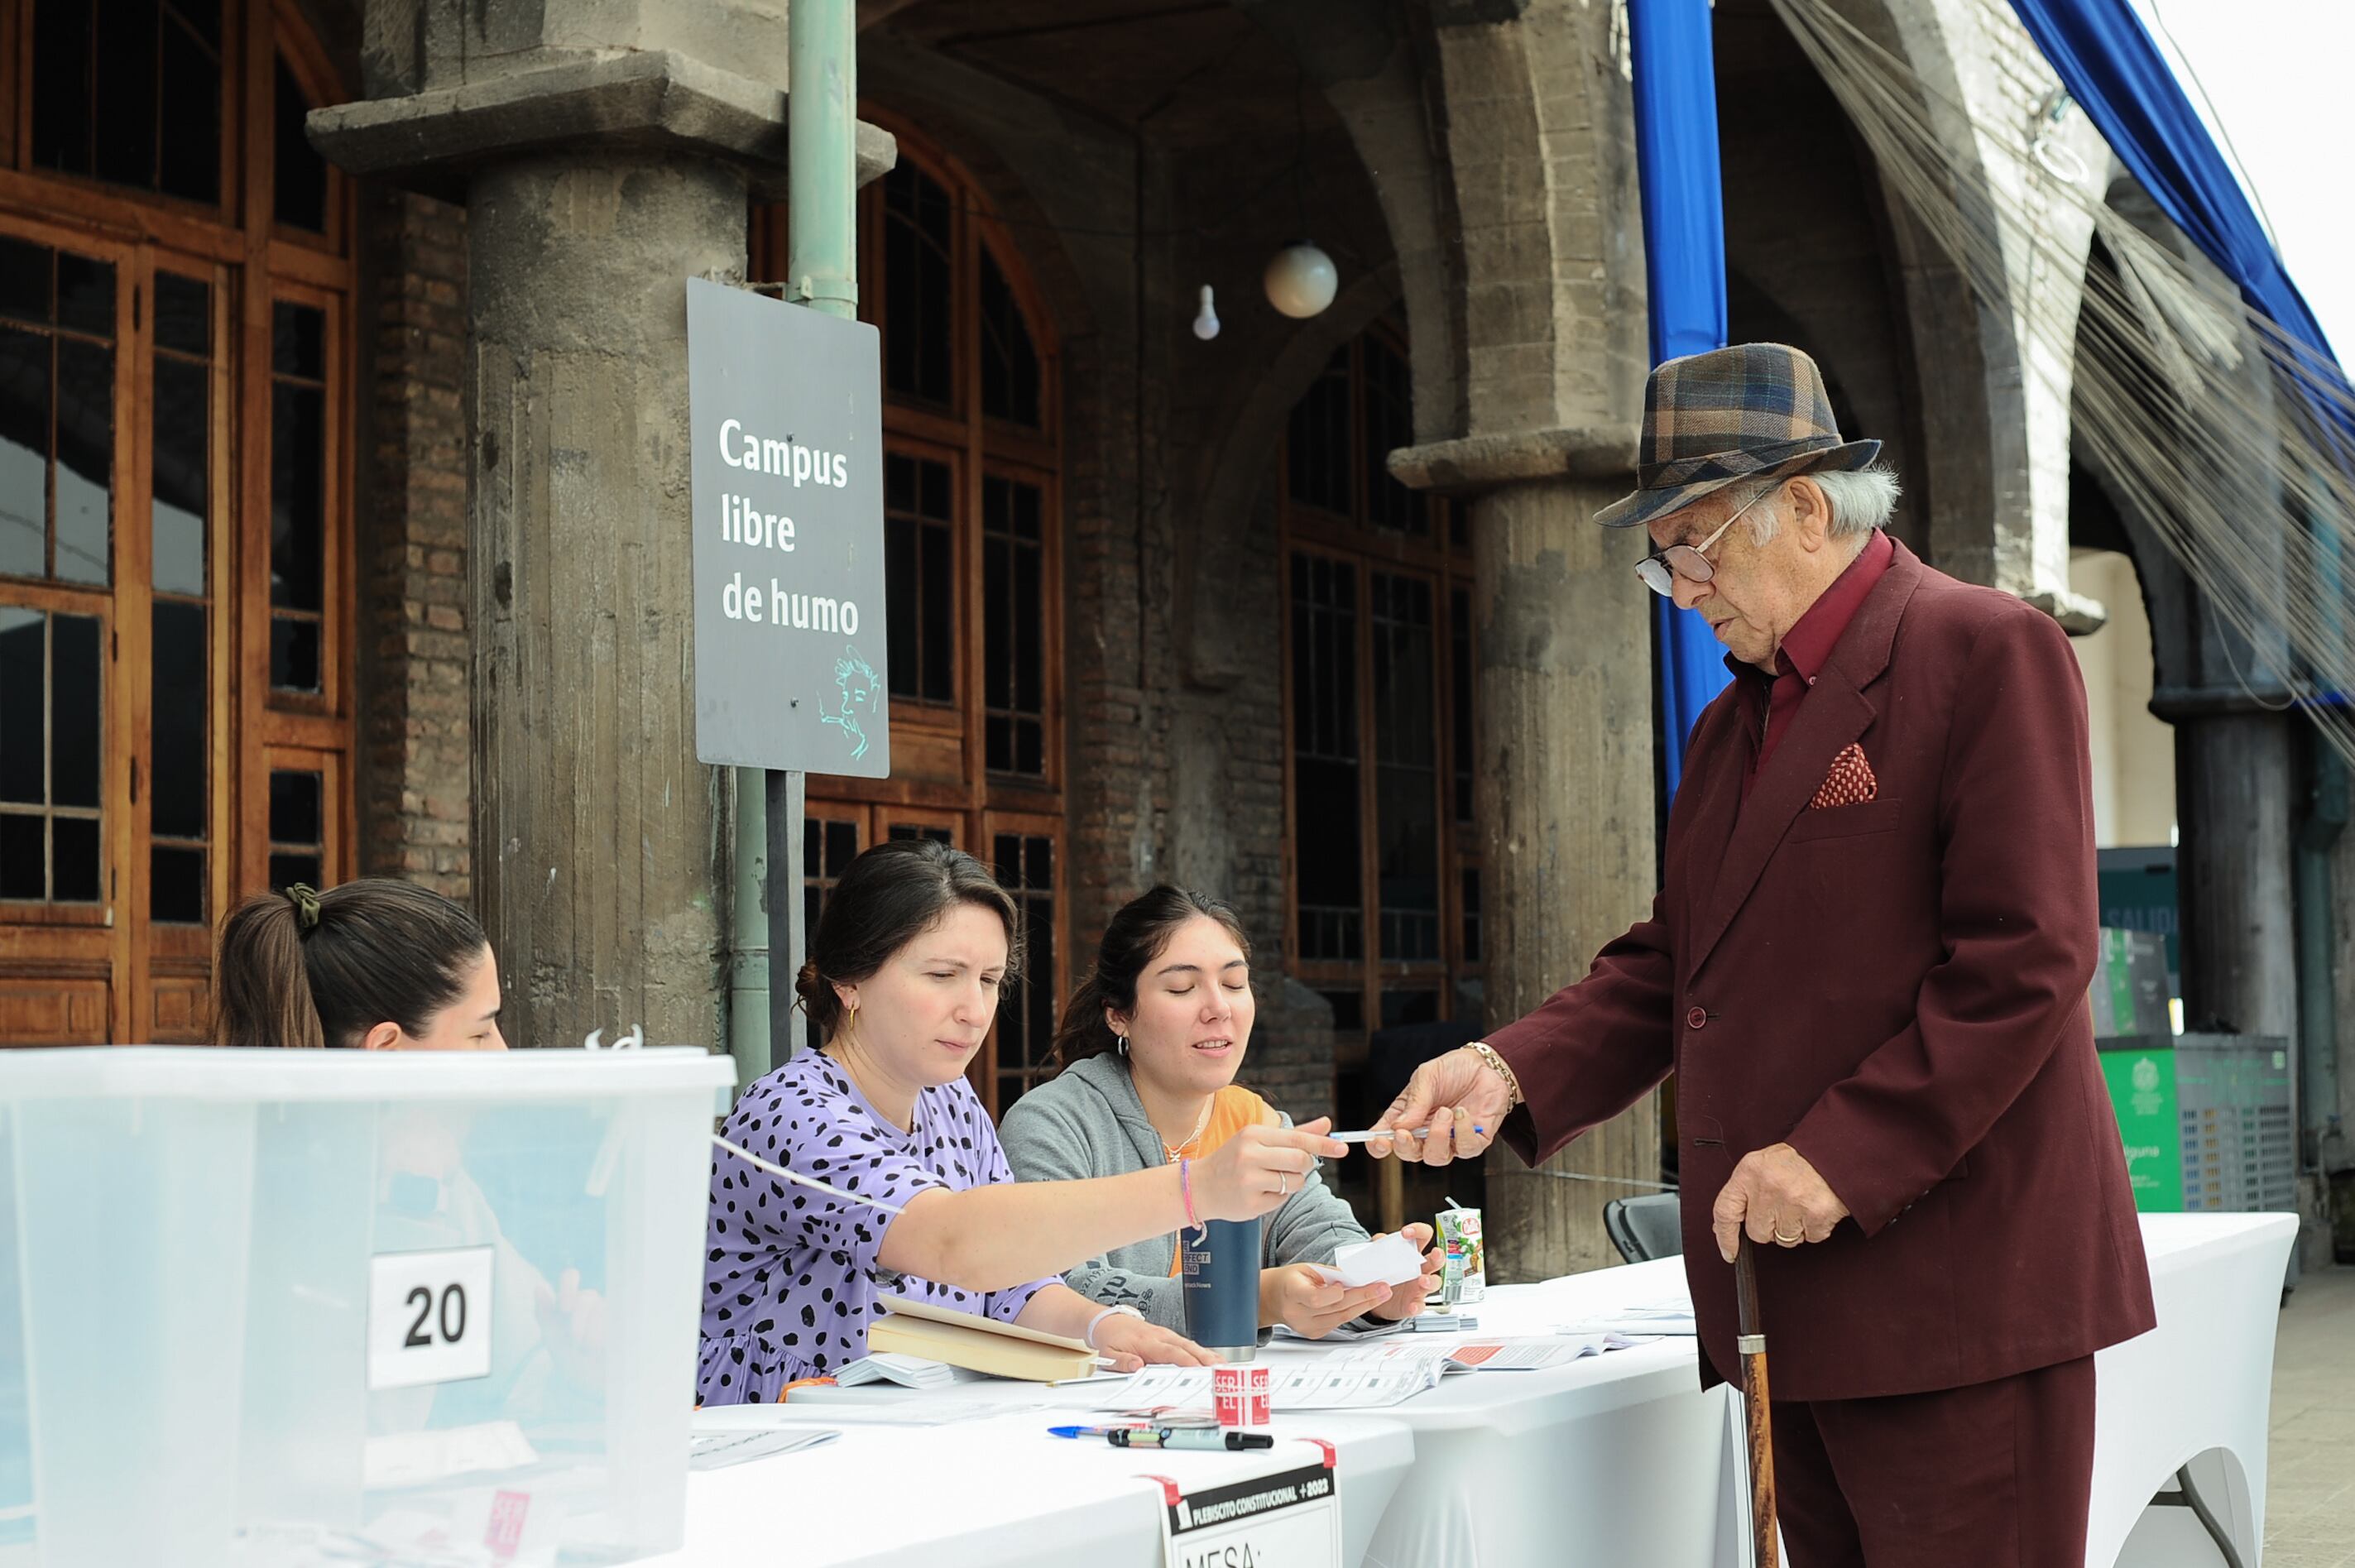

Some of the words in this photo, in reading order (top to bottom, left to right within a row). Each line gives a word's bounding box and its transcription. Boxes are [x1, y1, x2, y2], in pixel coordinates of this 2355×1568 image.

[720, 419, 847, 487] Campus
[722, 493, 795, 552] libre
[722, 572, 762, 622] de
[770, 578, 859, 635] humo
[2107, 907, 2178, 934] SALID
[405, 1283, 466, 1347] 20
[1216, 1375, 1235, 1393] SER
[1192, 1499, 1236, 1527] PLEBISCITO
[1235, 1485, 1297, 1516] CONSTITUCIONAL
